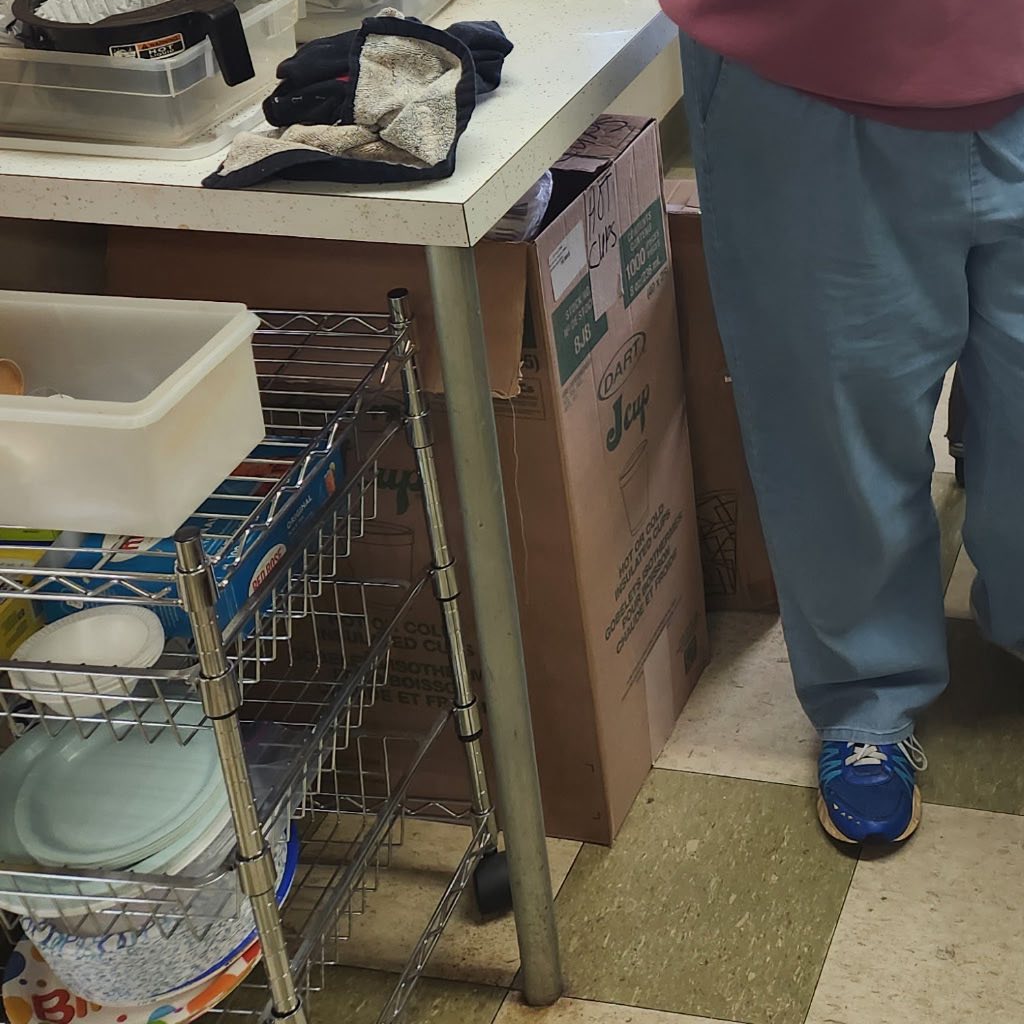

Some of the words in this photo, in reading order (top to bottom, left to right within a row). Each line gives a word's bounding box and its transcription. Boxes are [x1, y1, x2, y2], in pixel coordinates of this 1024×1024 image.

[148, 43, 175, 55] HOT
[625, 247, 646, 280] 1000
[604, 336, 641, 396] DART
[265, 548, 283, 576] ROSE
[618, 548, 633, 579] HOT
[634, 532, 645, 553] OR
[646, 503, 664, 535] COLD
[615, 537, 652, 602] INSULATED
